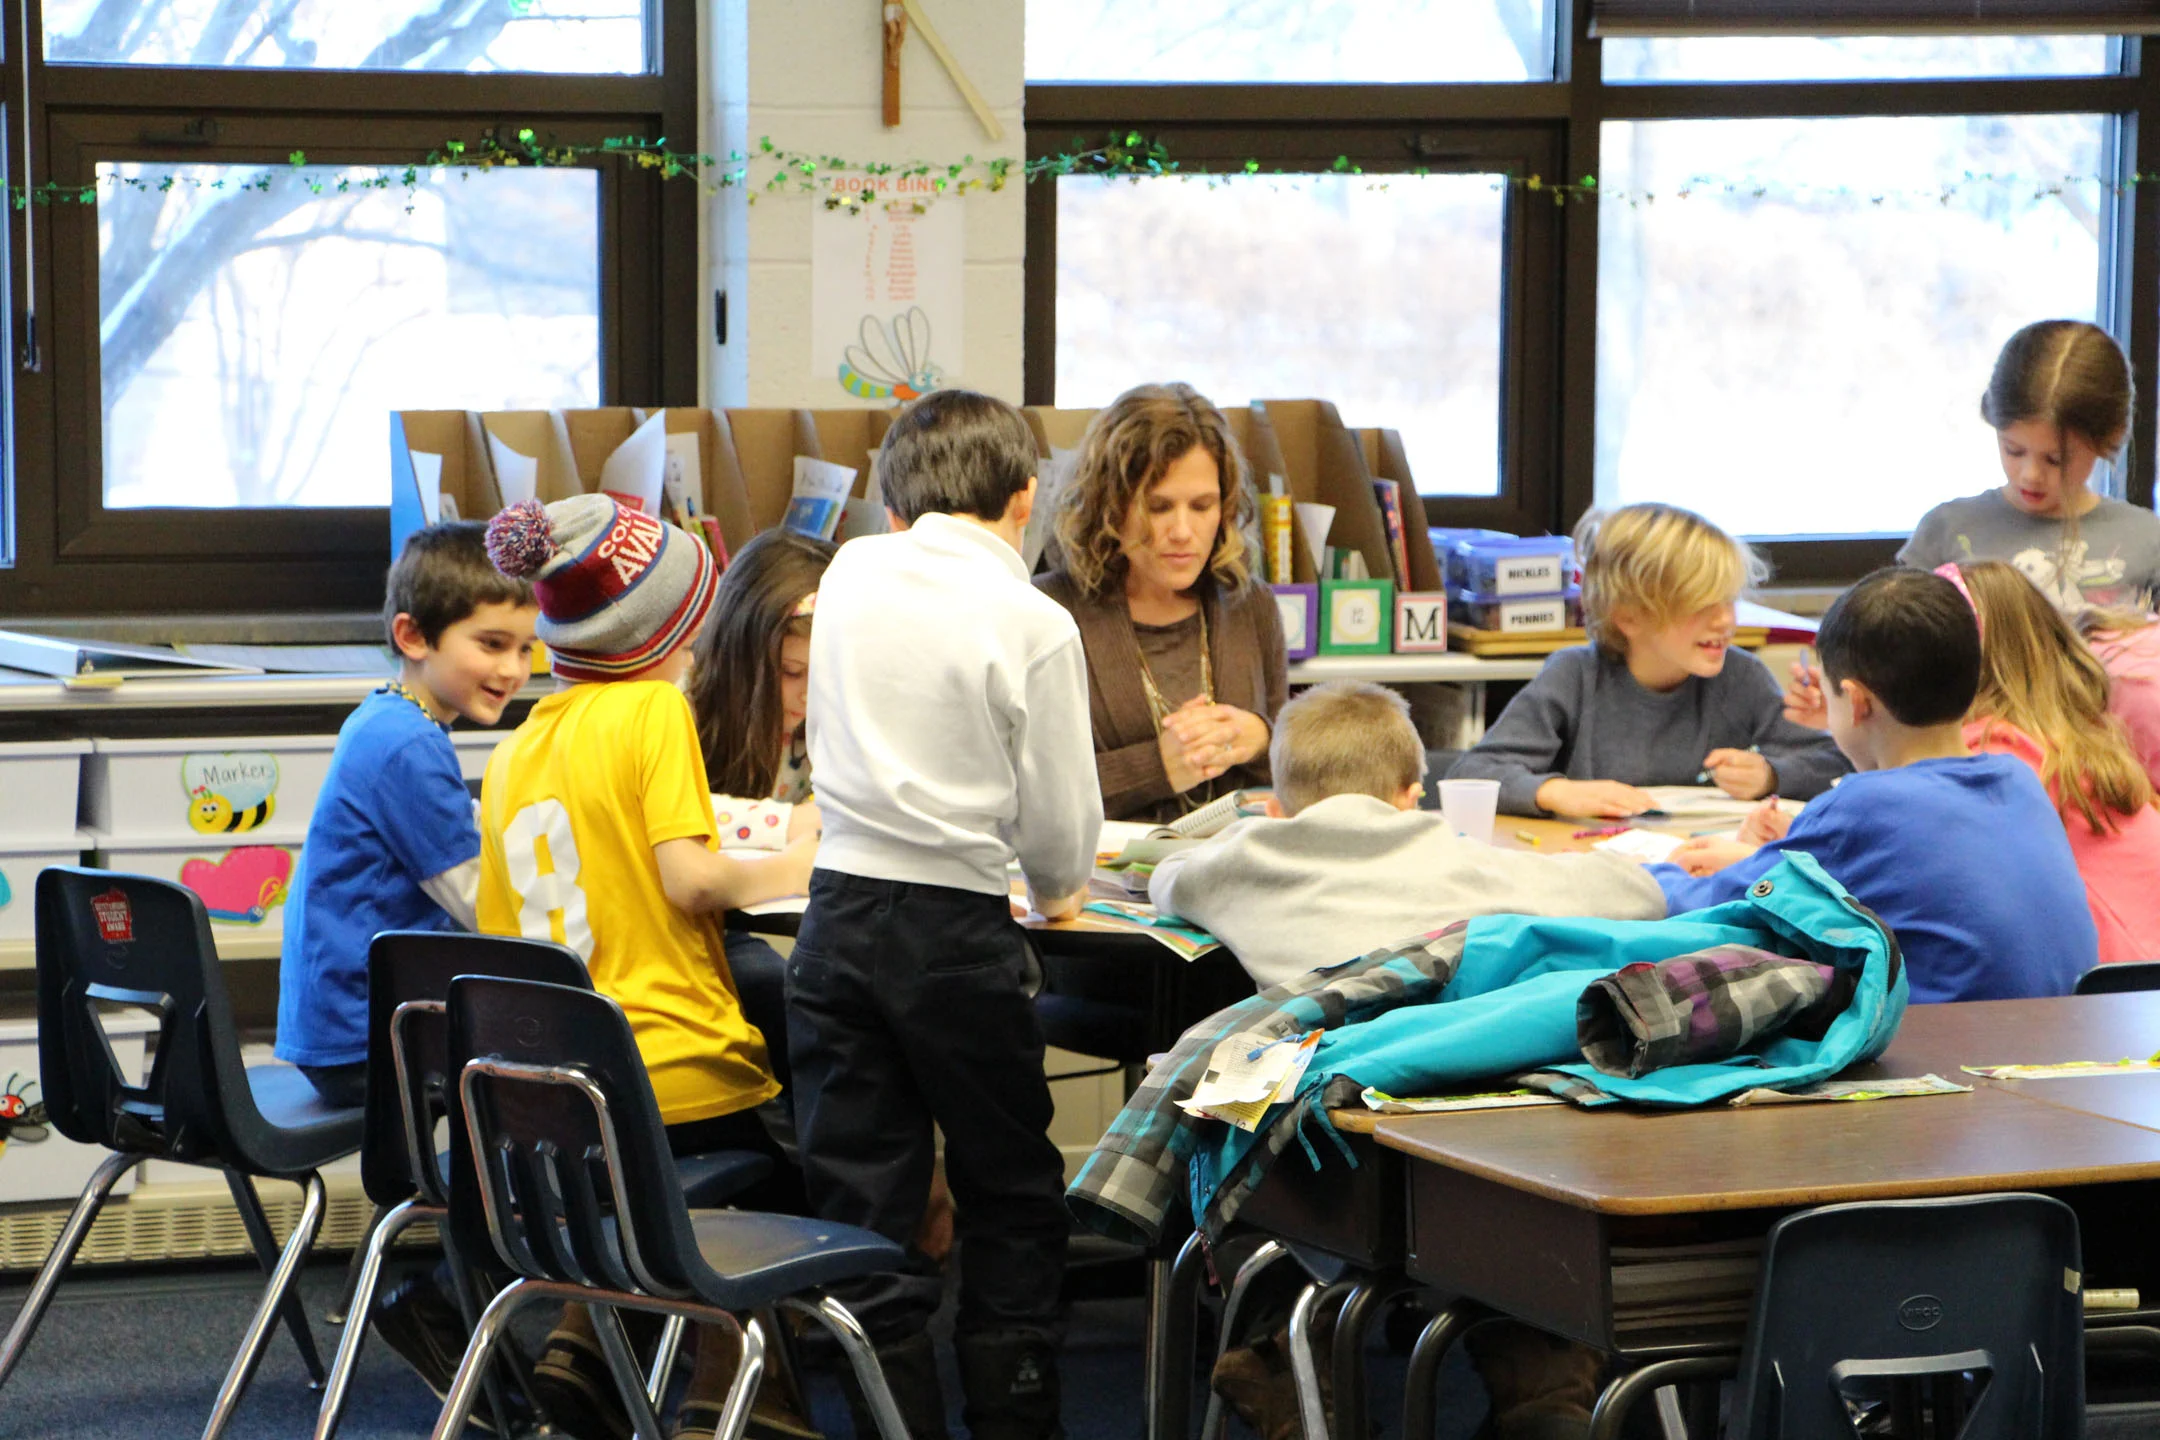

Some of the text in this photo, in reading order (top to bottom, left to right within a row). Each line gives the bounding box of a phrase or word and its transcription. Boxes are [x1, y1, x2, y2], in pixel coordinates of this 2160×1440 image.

[834, 178, 889, 192] BOOK
[1404, 607, 1440, 641] M
[1511, 611, 1555, 625] PENNIES
